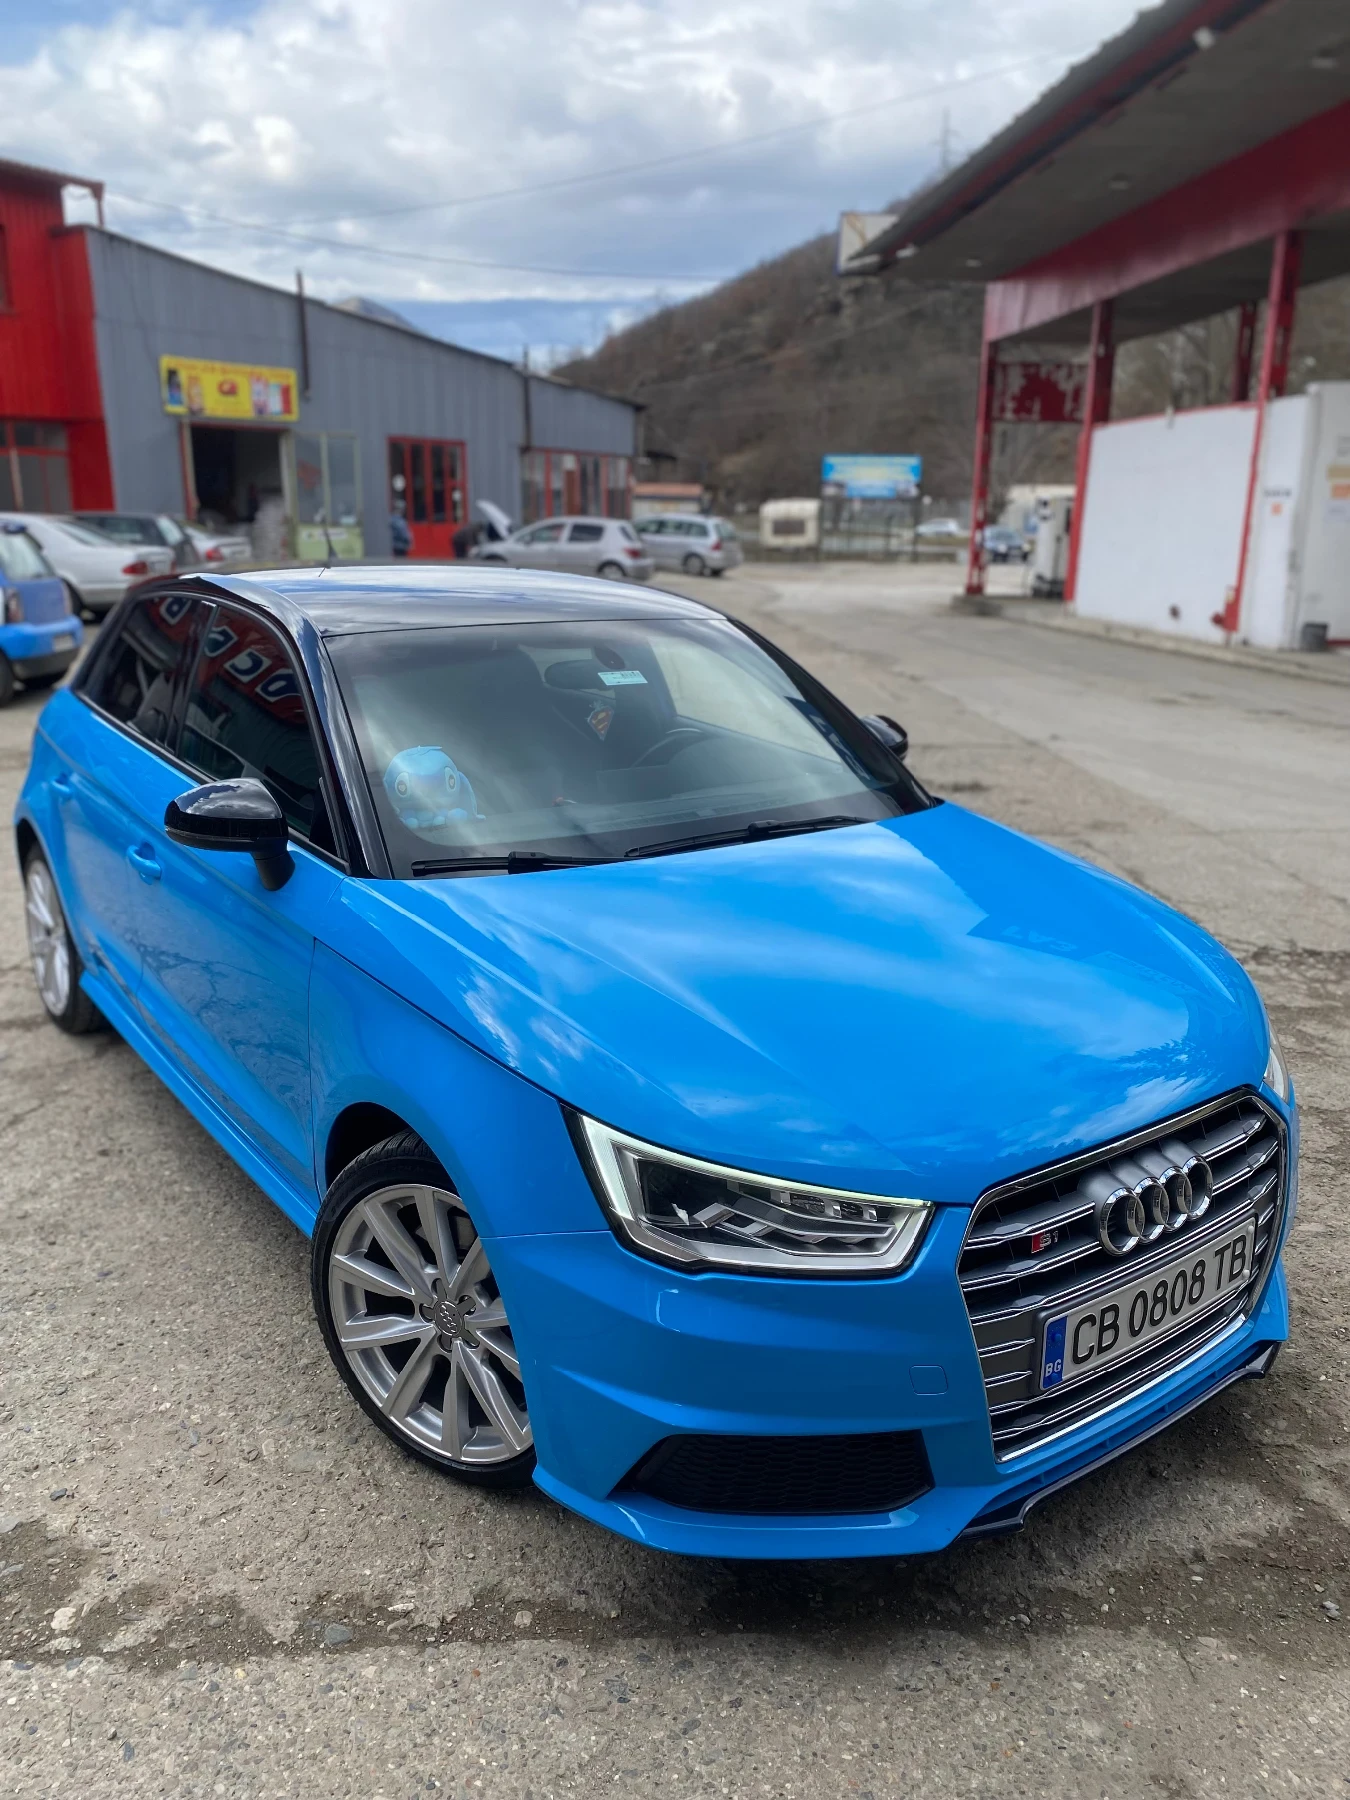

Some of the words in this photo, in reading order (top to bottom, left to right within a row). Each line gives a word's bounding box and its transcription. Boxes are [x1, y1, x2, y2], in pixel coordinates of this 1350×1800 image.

[1072, 1304, 1120, 1365] CB
[1128, 1258, 1206, 1338] 0808
[1213, 1234, 1247, 1291] TB
[1044, 1358, 1062, 1378] BG
